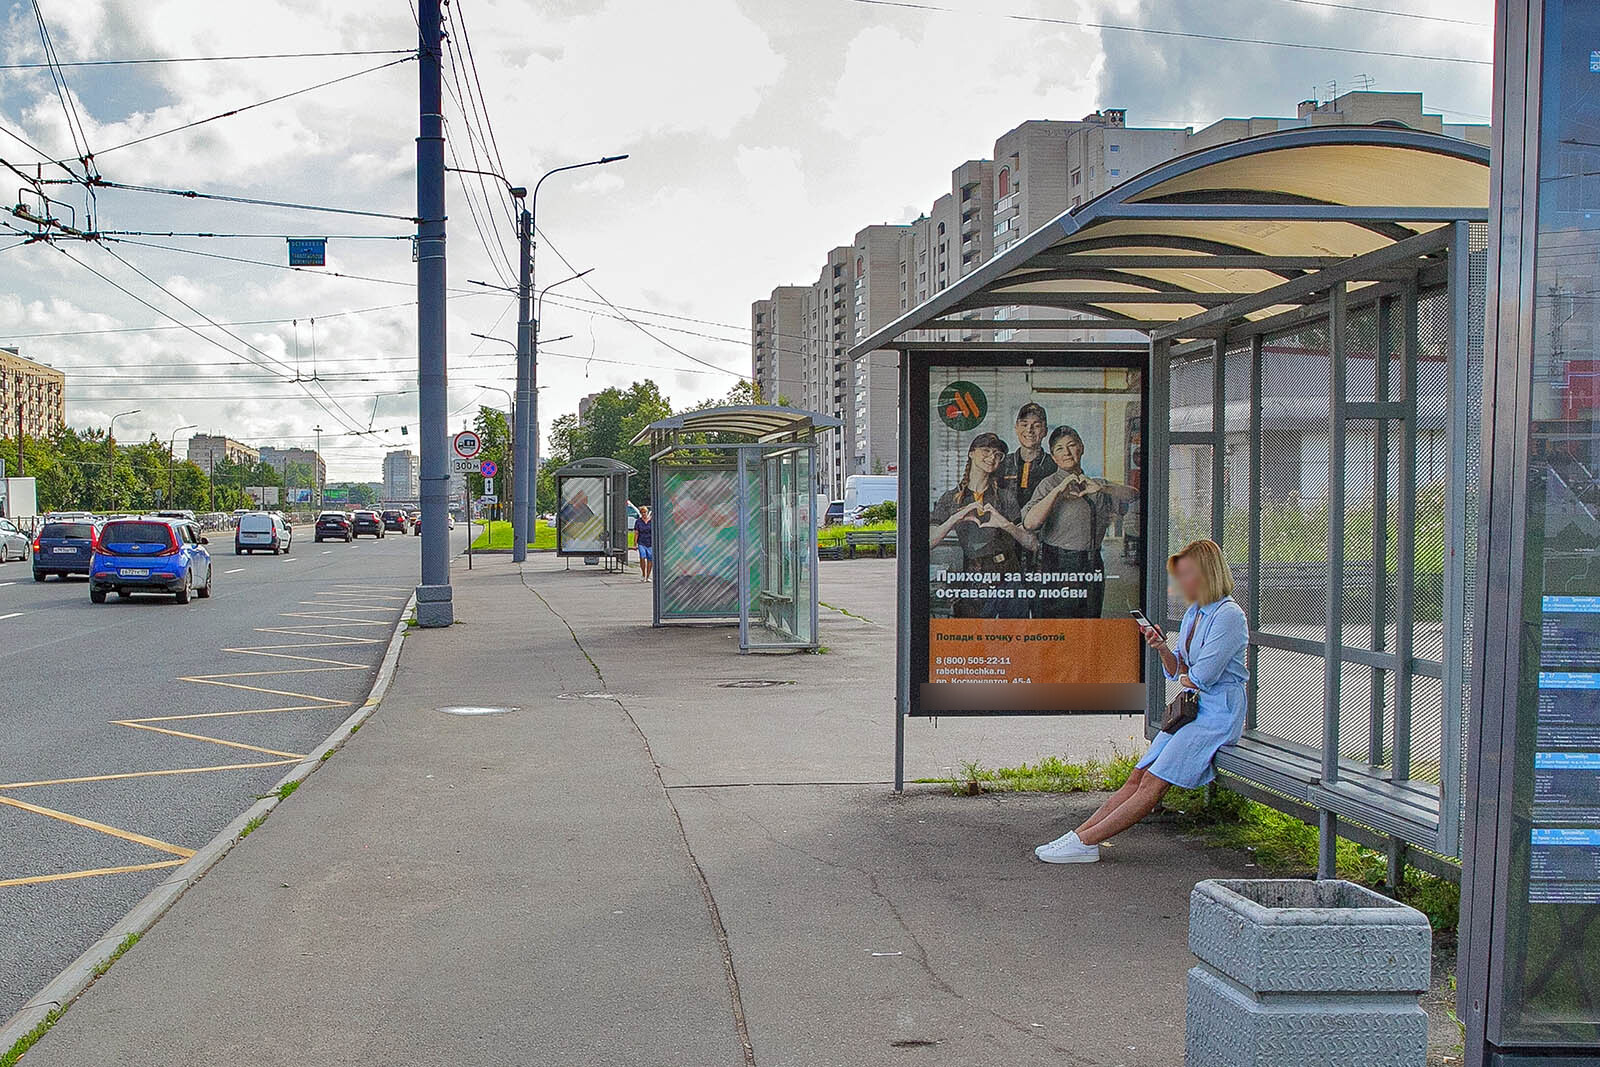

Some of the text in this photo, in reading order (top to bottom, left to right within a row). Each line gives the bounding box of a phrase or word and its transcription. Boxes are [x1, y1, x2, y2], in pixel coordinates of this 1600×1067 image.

[936, 570, 1000, 583] Приходи
[1004, 572, 1021, 582] за
[1025, 569, 1103, 584] зарплатой
[936, 586, 1088, 598] оставайся по любви
[936, 632, 973, 642] Попади
[985, 634, 1013, 642] точку
[1024, 632, 1065, 642] работой
[936, 655, 1011, 666] 8 (800) 505-22-11
[936, 667, 1006, 675] rabotaitochka.ru
